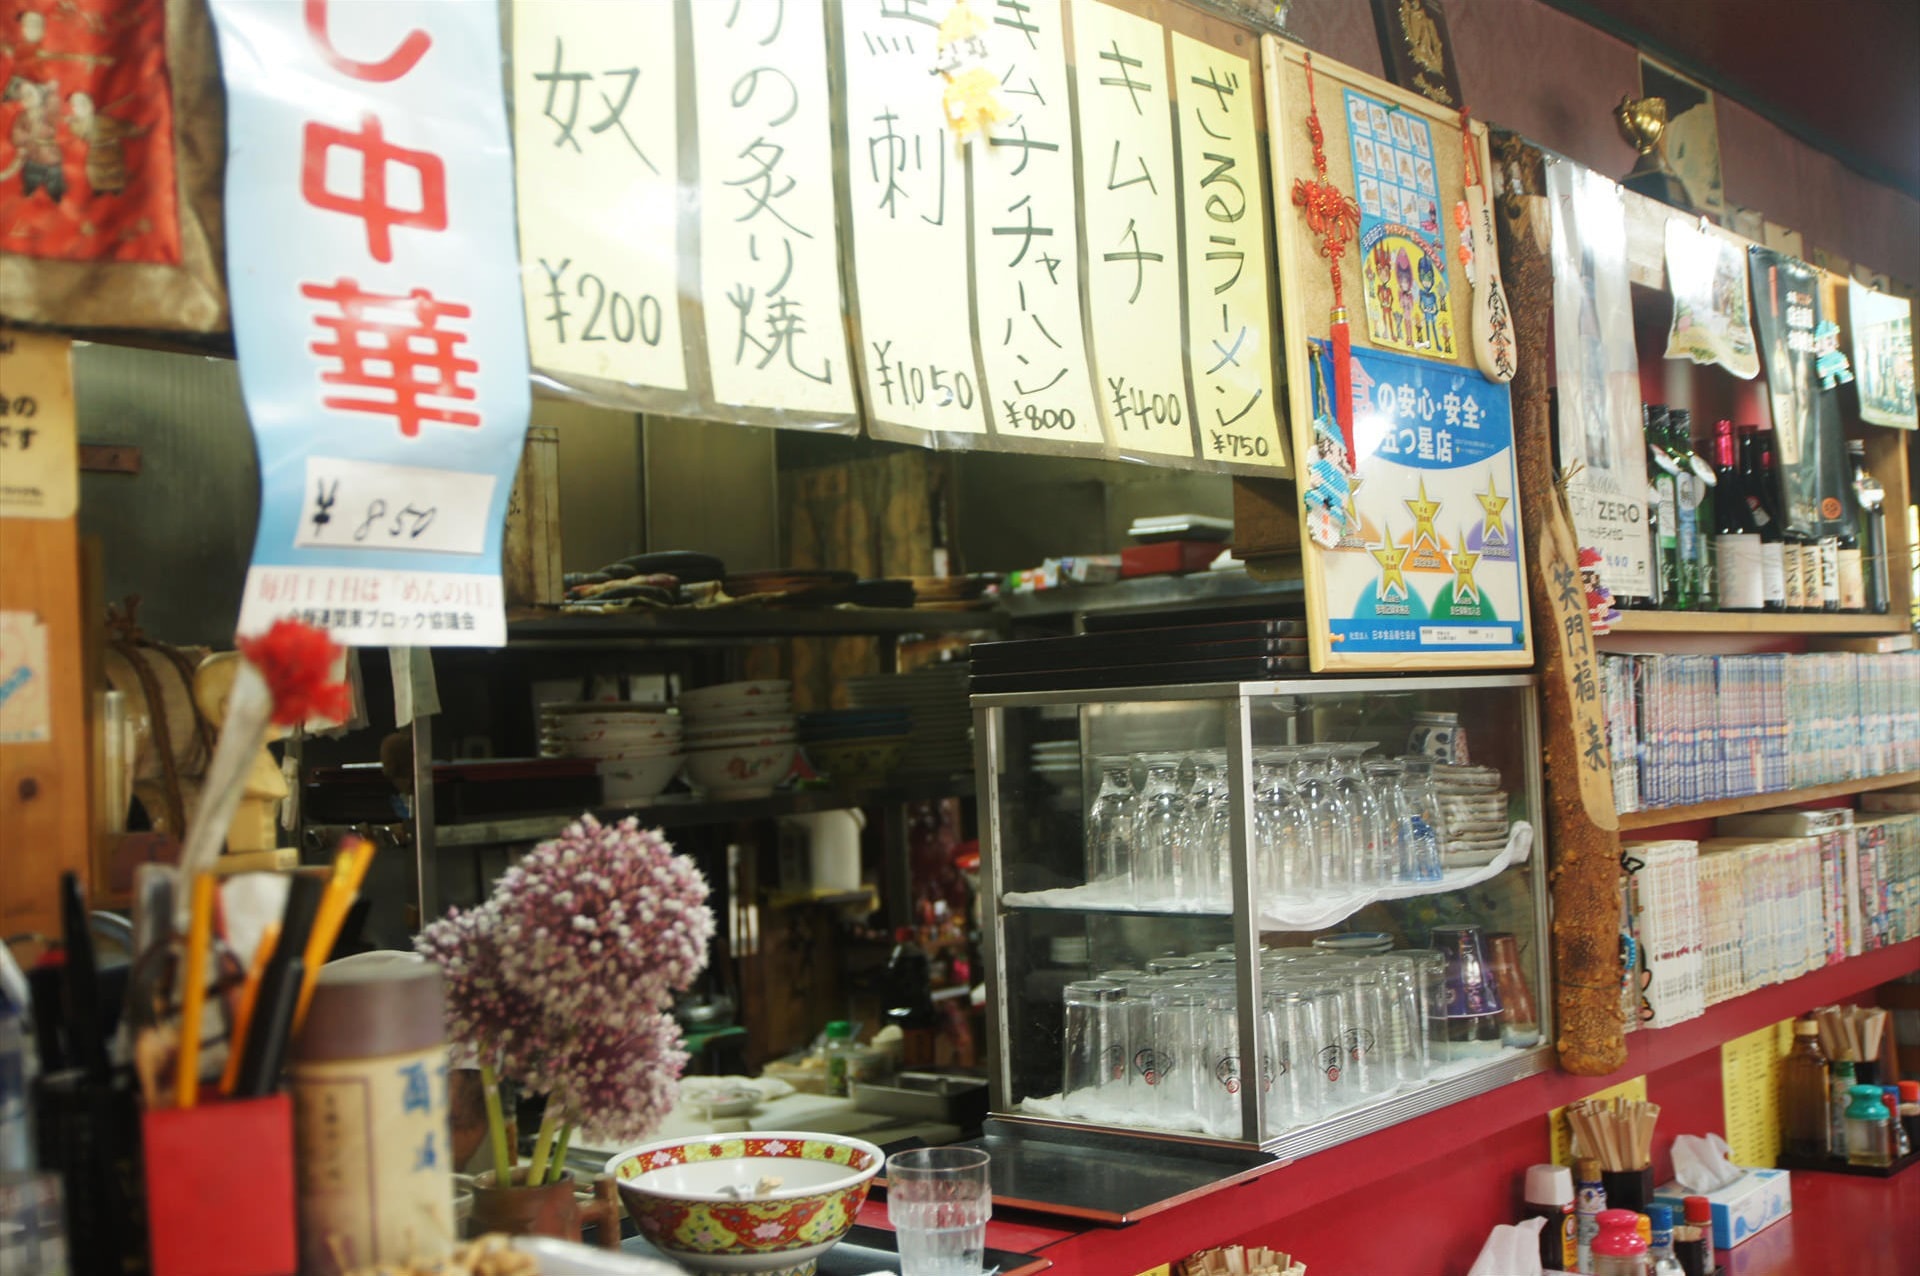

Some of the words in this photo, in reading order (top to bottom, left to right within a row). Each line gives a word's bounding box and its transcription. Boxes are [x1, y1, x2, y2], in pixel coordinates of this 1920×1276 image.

[533, 36, 660, 175] 奴
[989, 0, 1069, 395] キムチチャーハン
[1099, 40, 1164, 304] キムチ
[1191, 66, 1263, 427] ざるラーメン
[539, 257, 662, 348] ¥200
[872, 340, 974, 411] ¥1050
[1003, 400, 1076, 431] ¥800
[1107, 376, 1182, 431] ¥400
[1210, 430, 1270, 457] ¥750
[1597, 500, 1640, 523] ZERO
